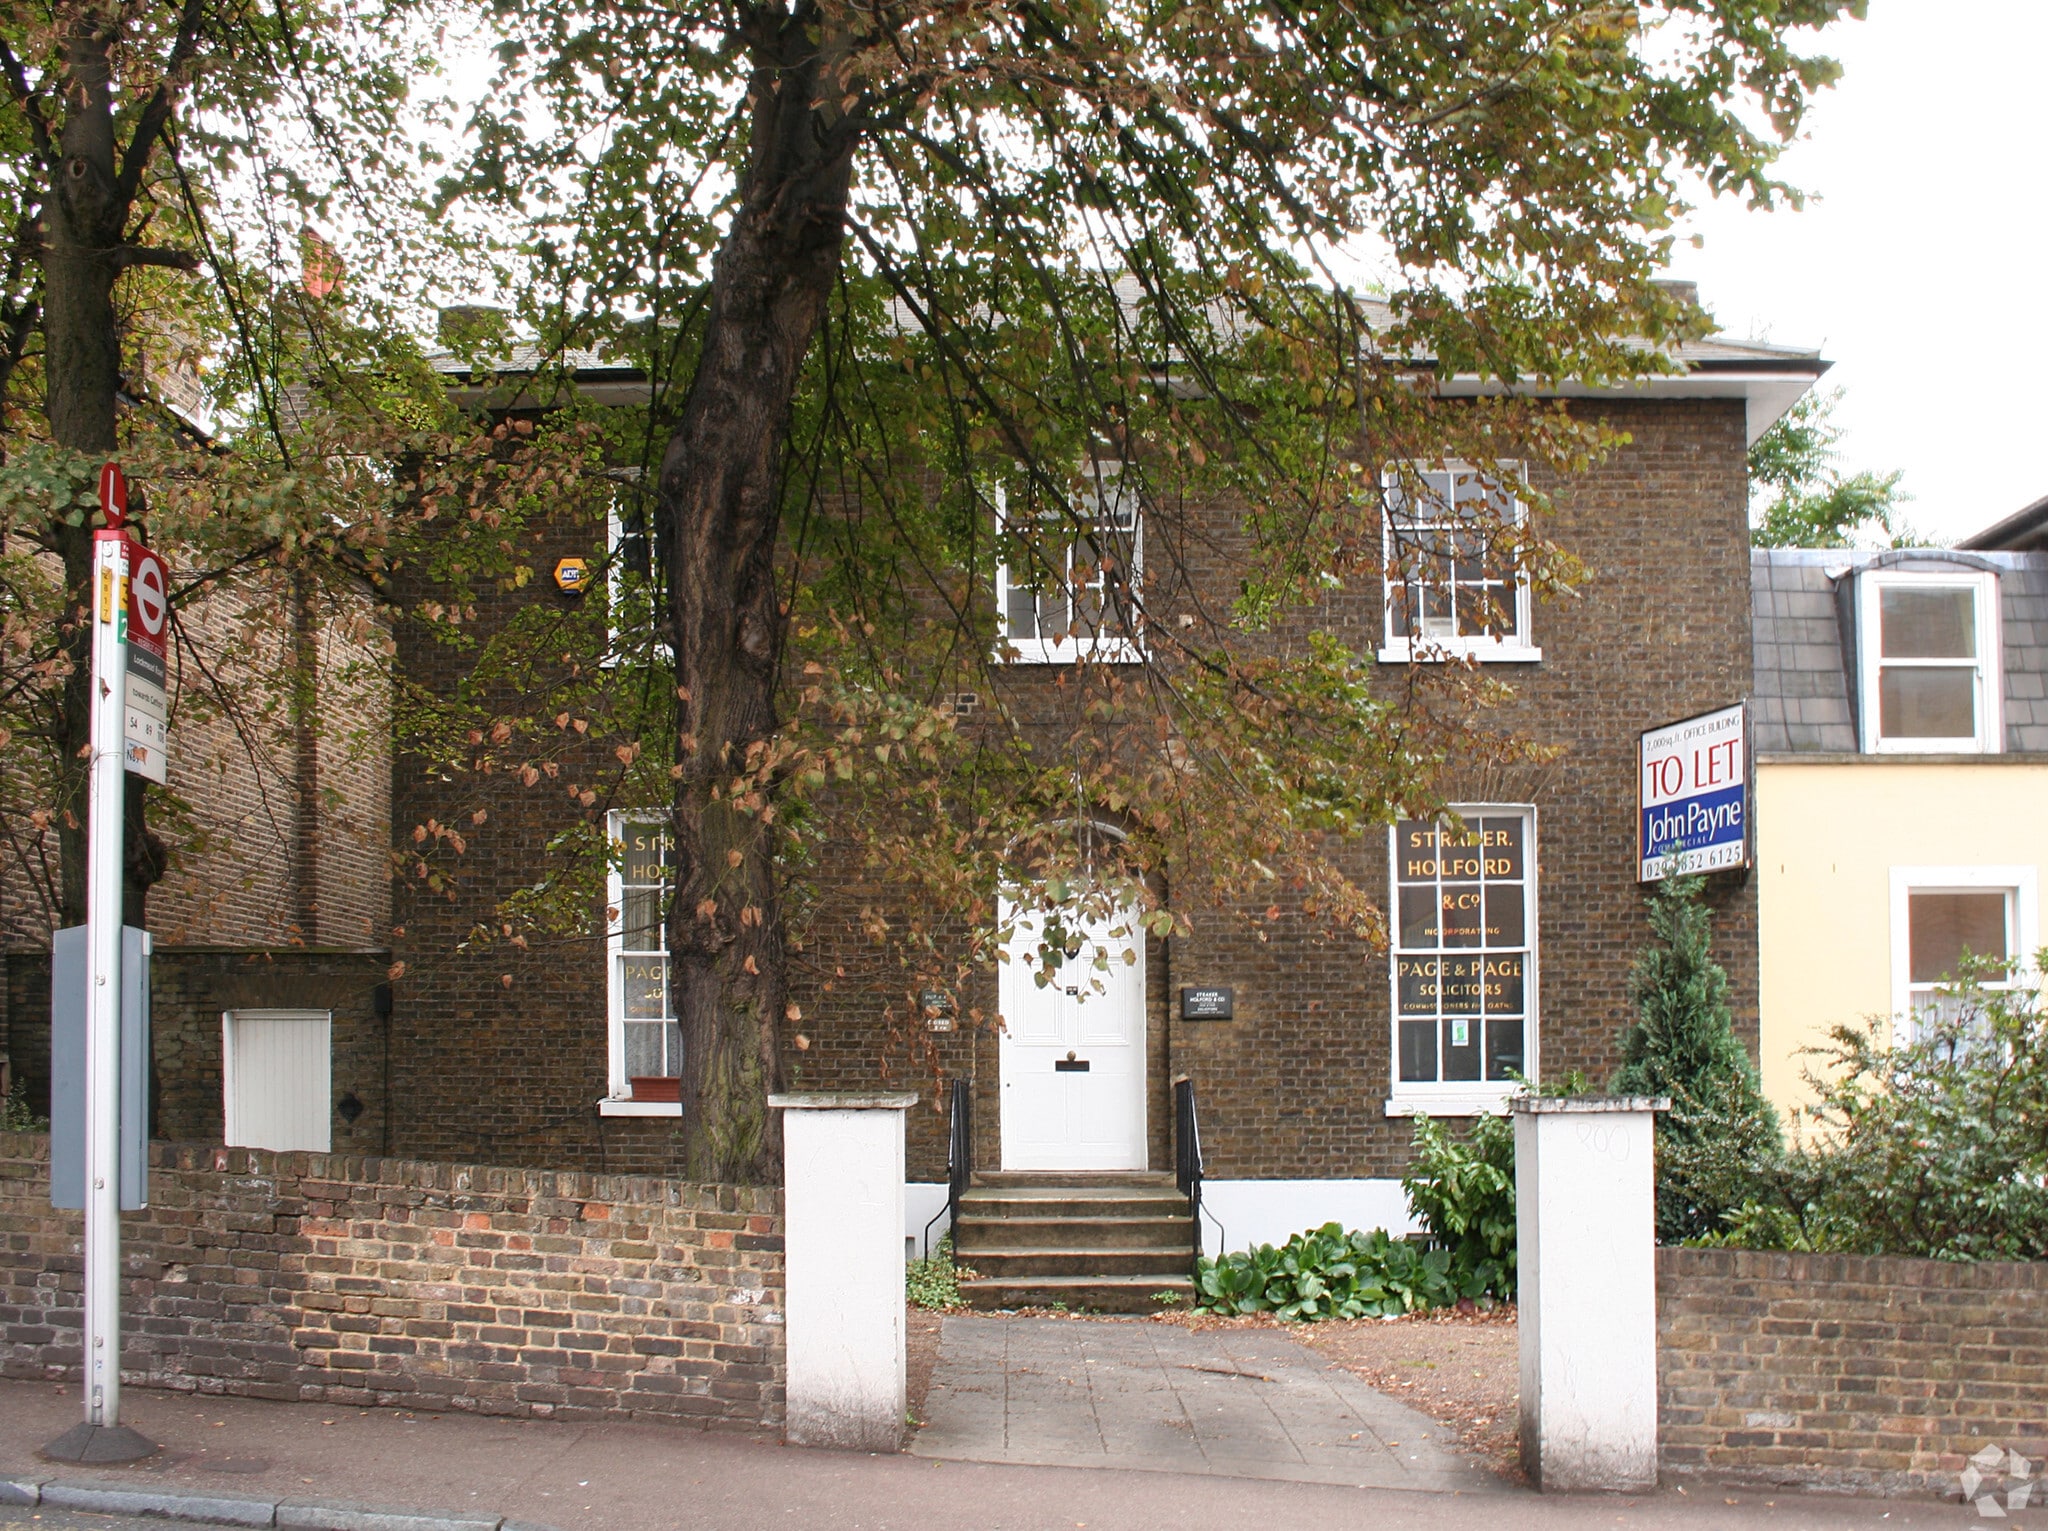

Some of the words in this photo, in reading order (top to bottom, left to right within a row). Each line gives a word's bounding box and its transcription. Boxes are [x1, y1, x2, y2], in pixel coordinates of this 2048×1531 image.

[561, 569, 578, 578] ADT
[129, 716, 138, 730] 54
[146, 723, 153, 736] 89
[1683, 725, 1706, 740] OFFICE
[1708, 715, 1740, 732] BUILDING
[1646, 755, 1684, 799] TO
[1694, 739, 1739, 789] LET
[1646, 807, 1685, 855] John
[1687, 801, 1741, 841] Payne
[1410, 830, 1513, 848] STRAER.
[1709, 846, 1740, 866] 6125
[1408, 858, 1511, 876] HOLFORD
[1442, 894, 1455, 910] &
[1424, 927, 1500, 936] INCORPORATNG
[1399, 961, 1450, 977] PAGE
[1454, 963, 1466, 977] &
[1471, 961, 1522, 977] PAGE
[1420, 984, 1502, 996] SOLICITORS
[1403, 1002, 1469, 1010] COMMISSONERS
